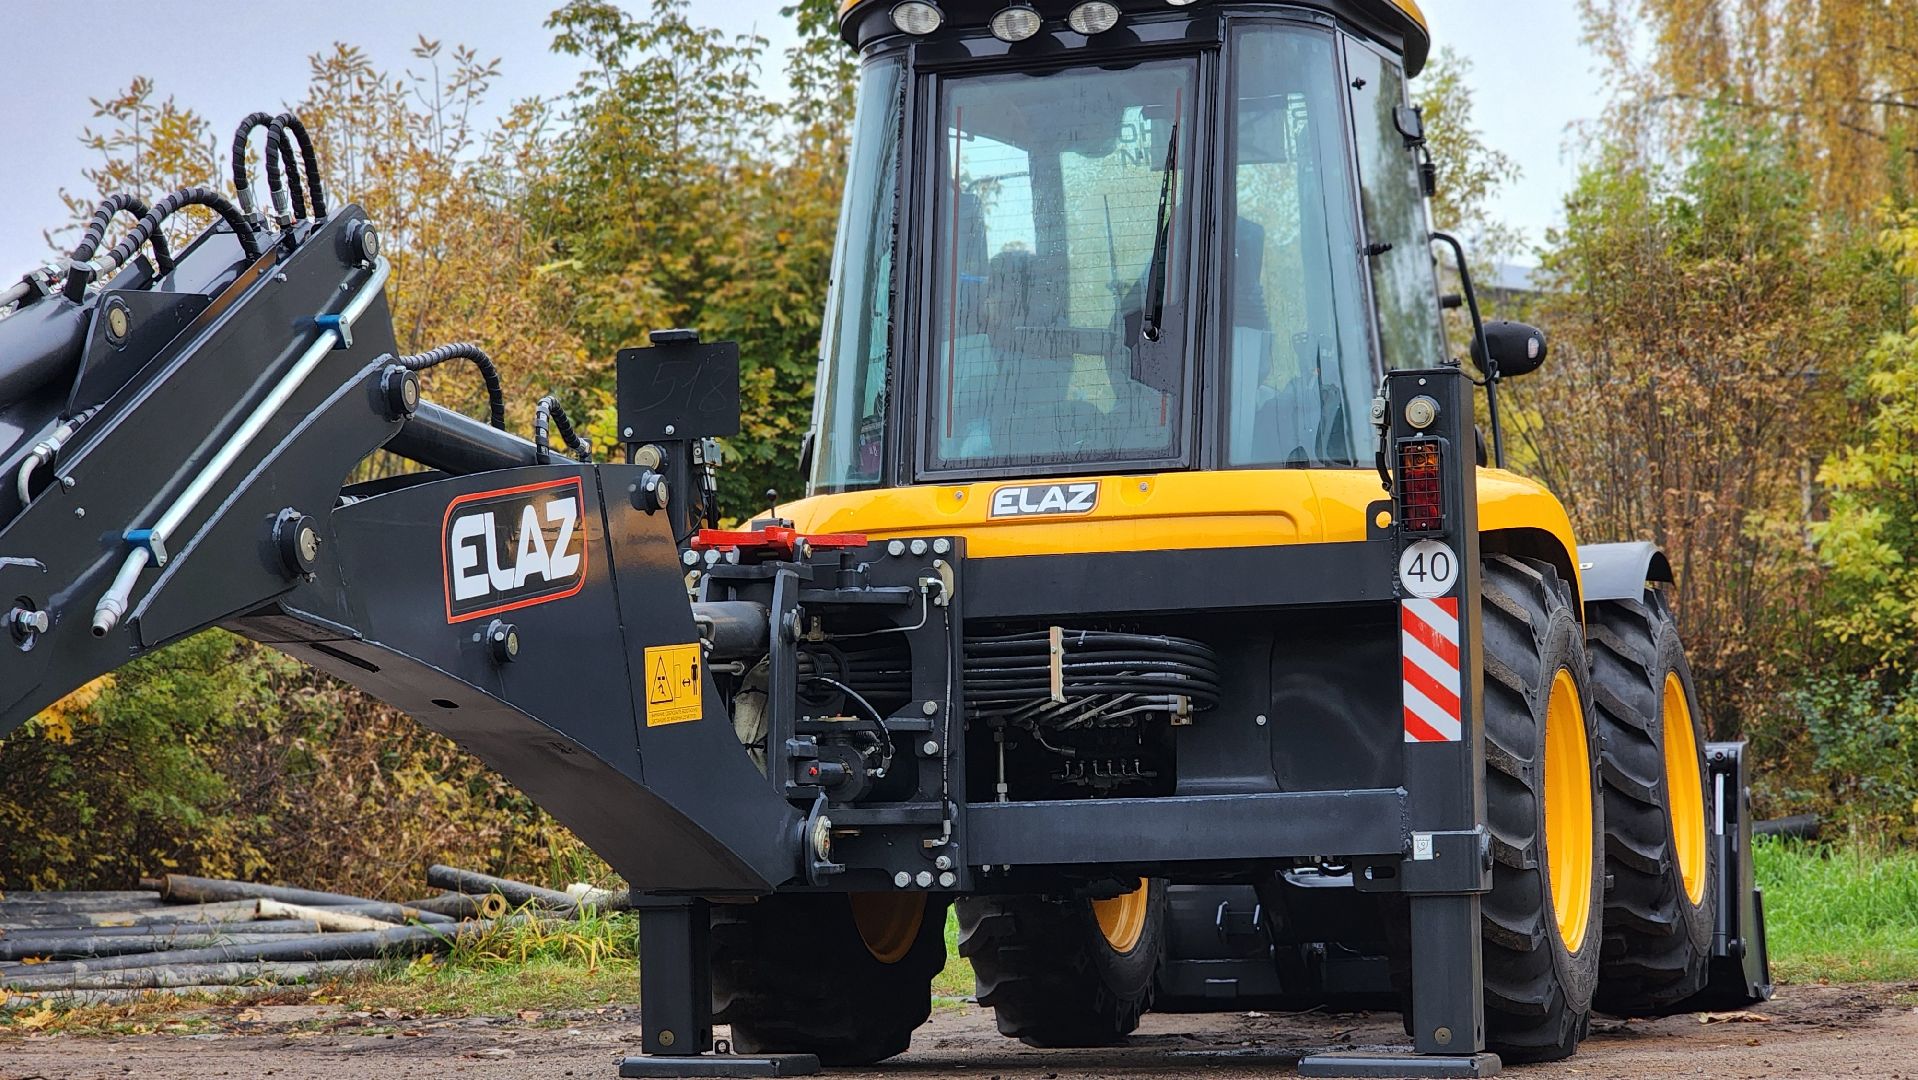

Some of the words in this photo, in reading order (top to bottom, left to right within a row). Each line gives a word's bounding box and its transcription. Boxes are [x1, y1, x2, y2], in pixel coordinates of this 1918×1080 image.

[993, 483, 1096, 515] ELAZ
[451, 496, 580, 600] ELAZ
[1407, 551, 1450, 582] 40
